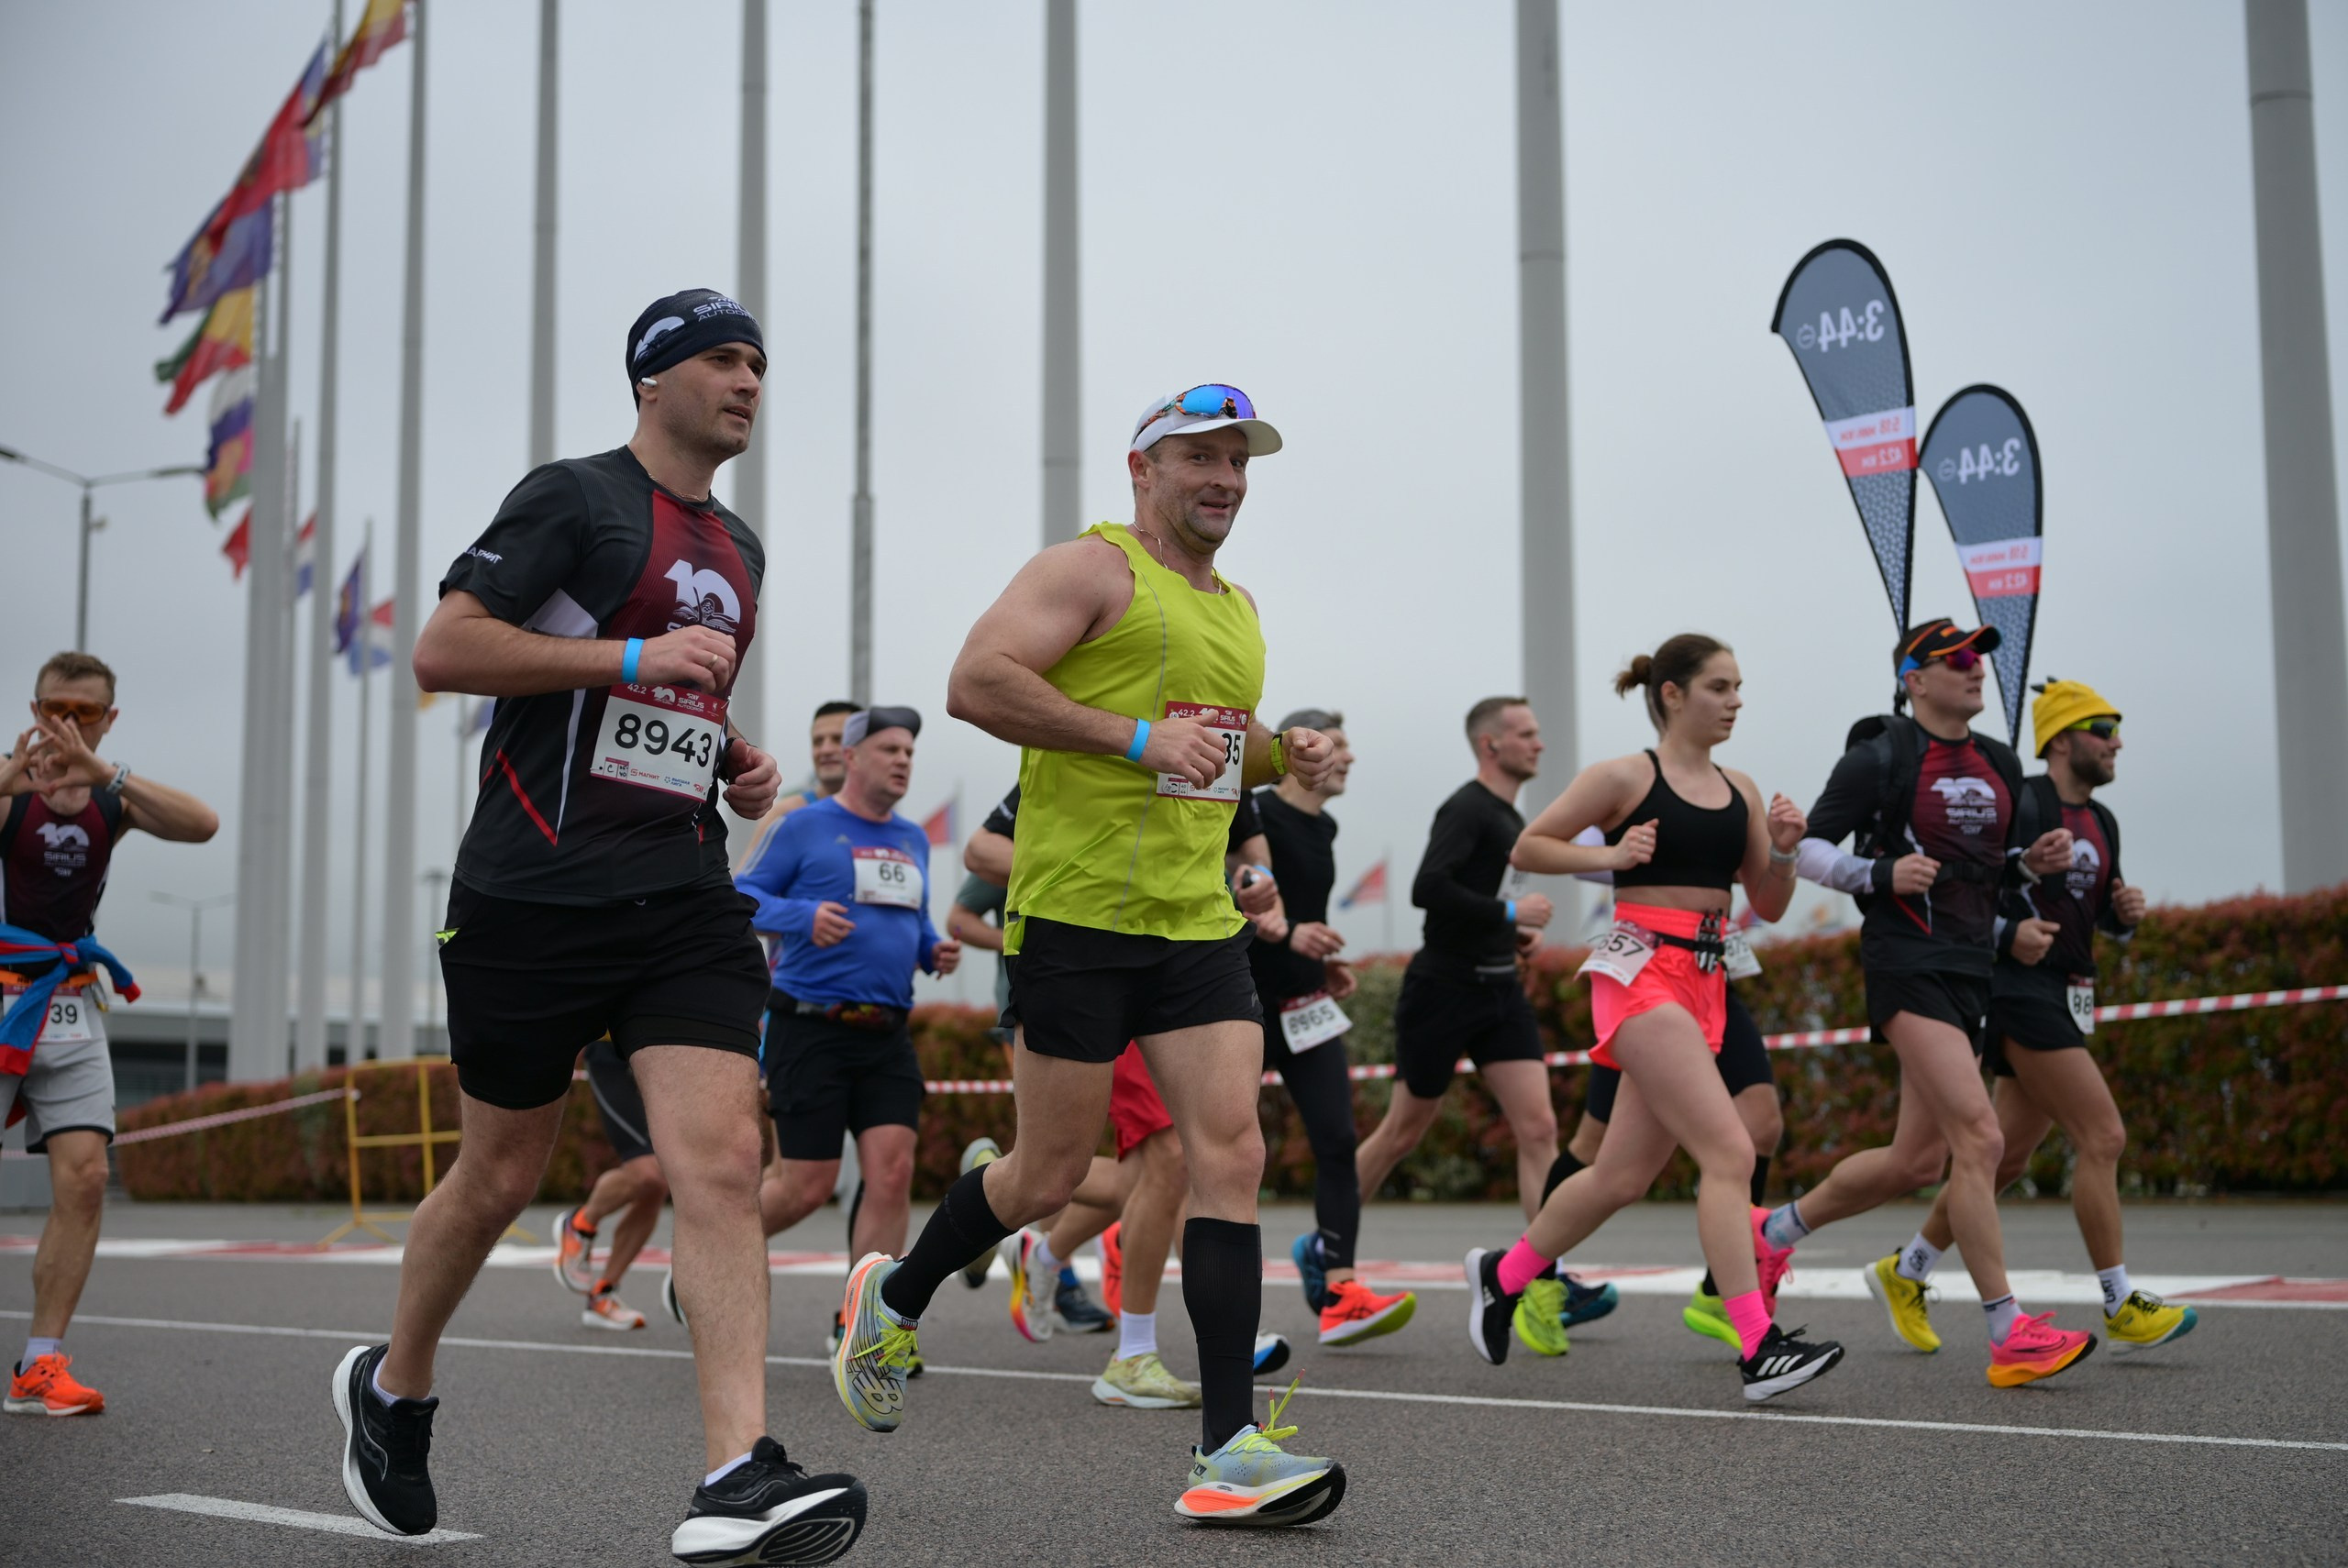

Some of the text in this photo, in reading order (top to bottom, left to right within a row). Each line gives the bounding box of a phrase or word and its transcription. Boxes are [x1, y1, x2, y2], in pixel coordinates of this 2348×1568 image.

[467, 547, 503, 564] АГНИТ
[627, 683, 648, 695] 42.2
[678, 697, 705, 710] SIRIUS
[1178, 709, 1195, 717] 42.2
[615, 713, 712, 767] 8943
[1222, 733, 1241, 766] 35
[637, 771, 660, 781] МАГНИТ
[879, 862, 906, 883] 66
[50, 1004, 78, 1024] 39
